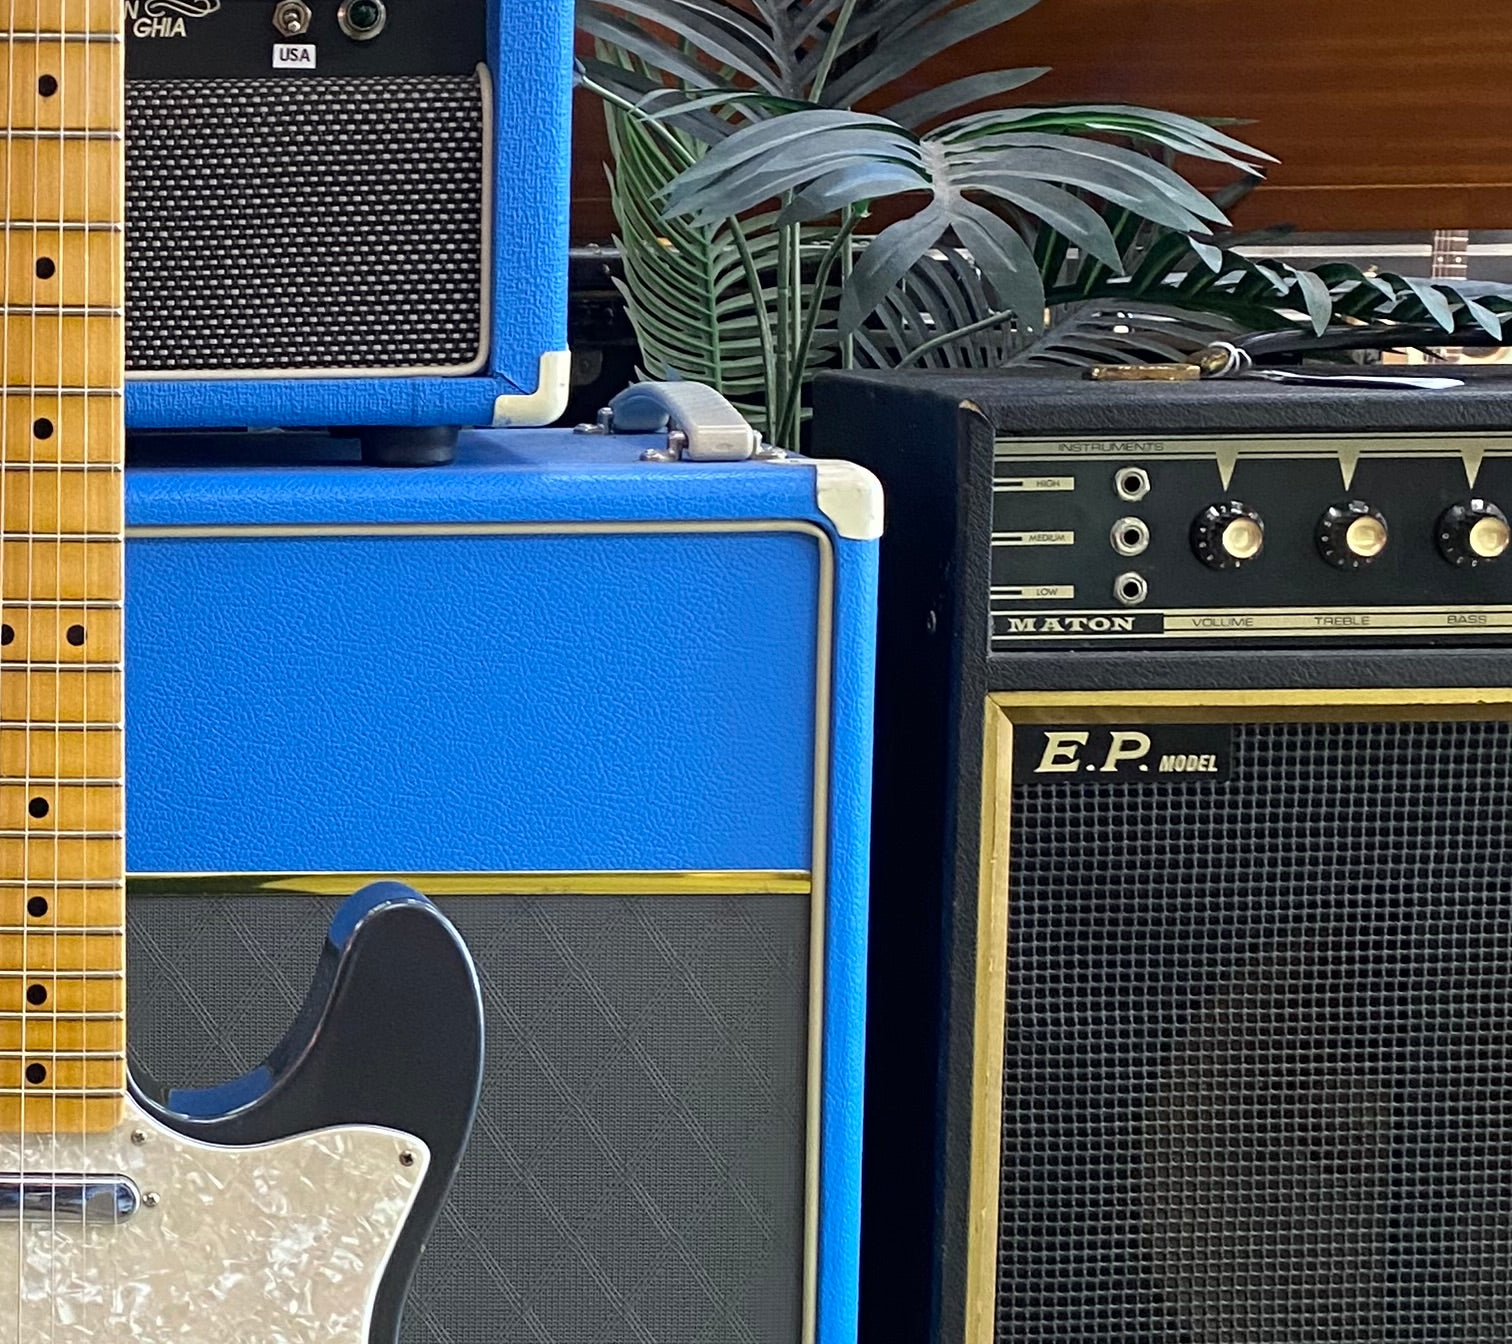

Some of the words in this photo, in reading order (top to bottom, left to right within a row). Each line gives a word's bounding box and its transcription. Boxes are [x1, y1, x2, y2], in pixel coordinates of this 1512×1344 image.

[133, 17, 187, 38] GHIA
[279, 47, 311, 62] USA
[1058, 442, 1165, 453] INSTRUMENTS
[1035, 479, 1061, 488] HIGH
[1028, 533, 1066, 543] MEDIUM
[1035, 587, 1059, 597] LOW
[1007, 615, 1137, 633] MATON
[1191, 617, 1254, 628] VOLUME
[1314, 616, 1371, 626] TREBLE
[1446, 614, 1488, 624] BASS
[1034, 731, 1151, 774] E.P.
[1159, 754, 1219, 773] MODEL
